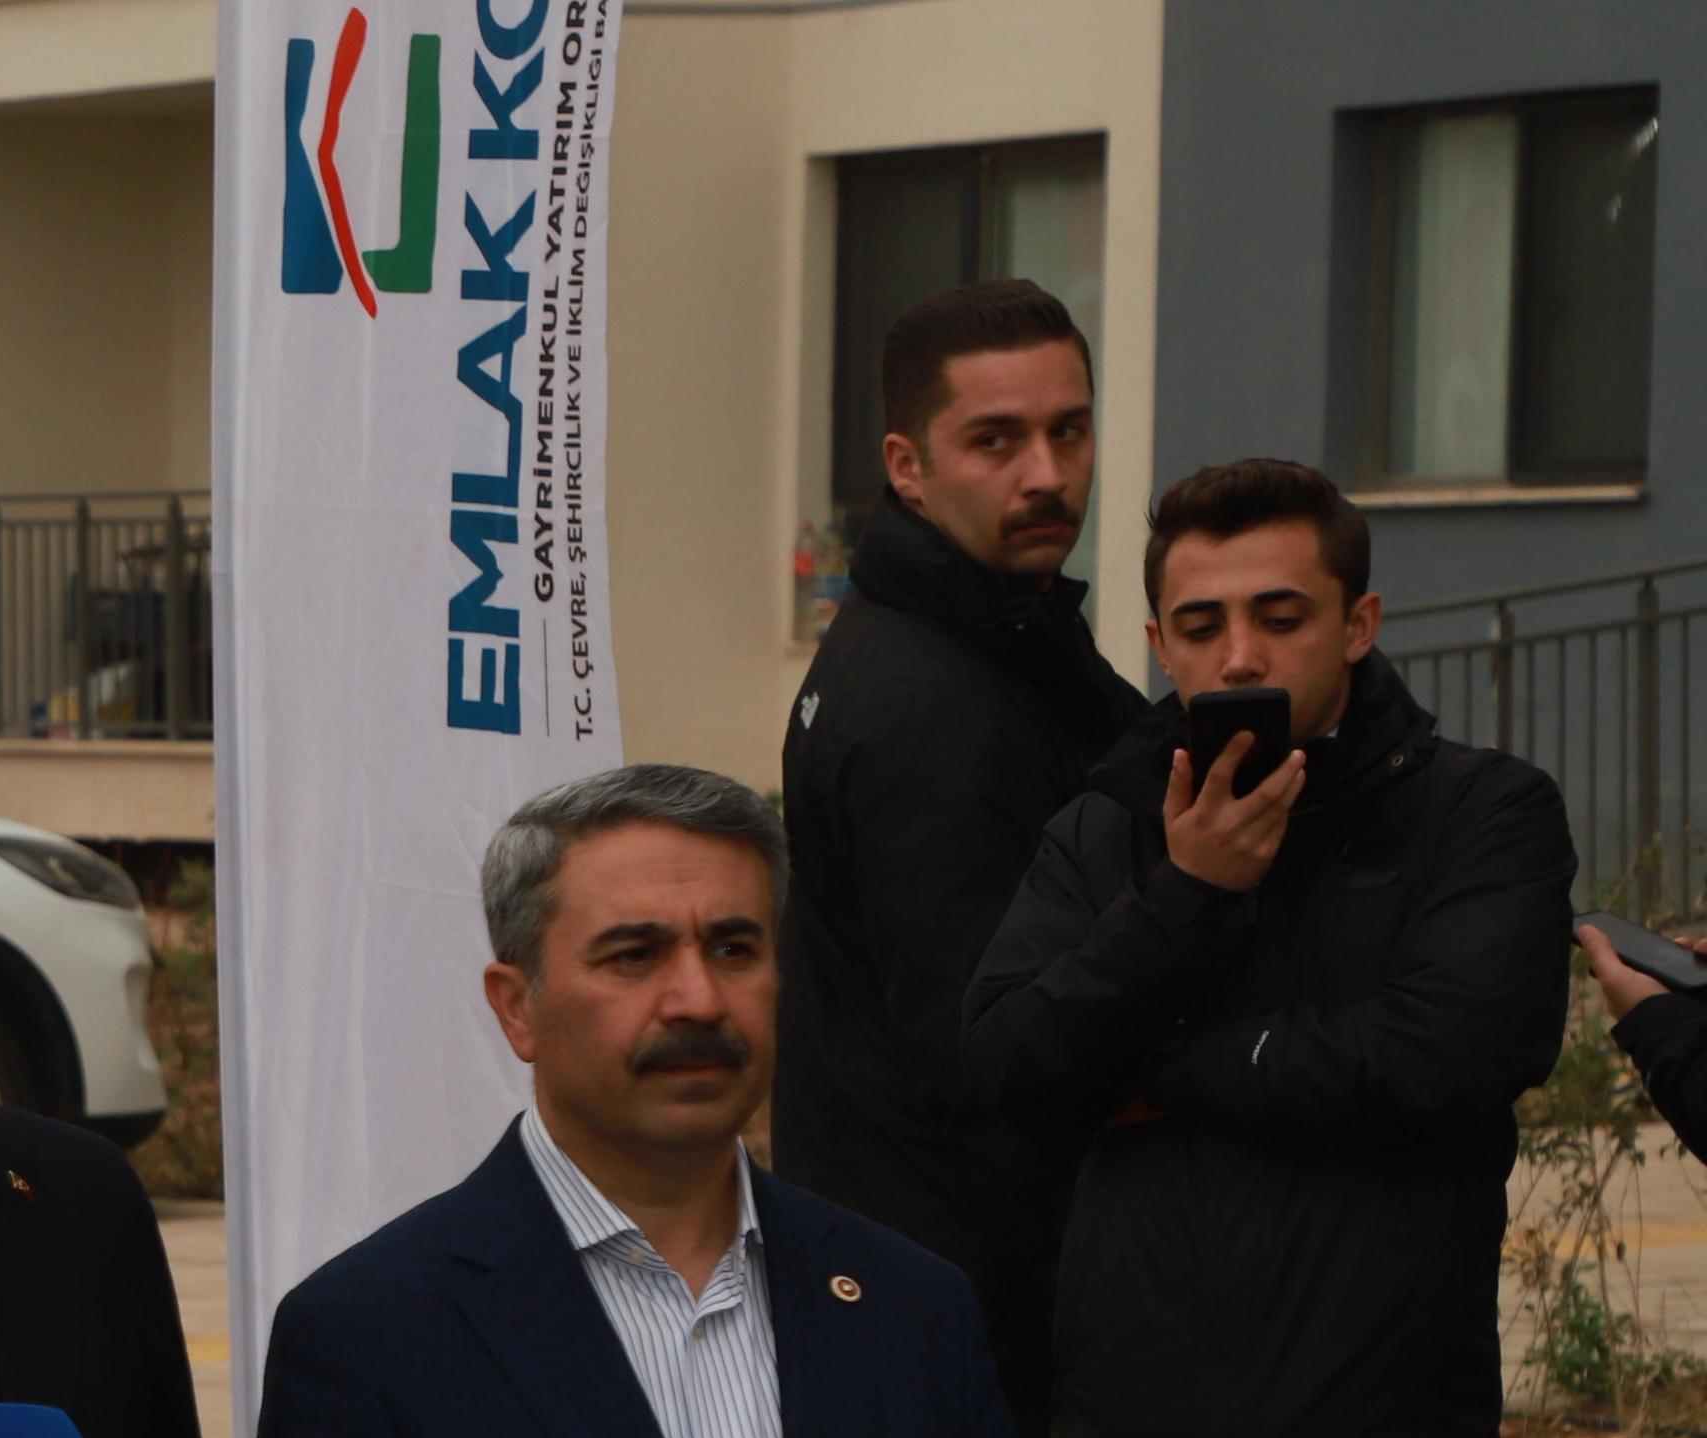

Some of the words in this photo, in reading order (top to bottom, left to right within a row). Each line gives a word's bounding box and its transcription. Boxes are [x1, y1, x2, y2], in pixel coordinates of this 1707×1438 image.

[544, 81, 578, 264] YATIRIM
[573, 49, 603, 238] DEĞİŞİKLİĞİ
[564, 248, 585, 336] İKLİM
[567, 345, 582, 385] VE
[446, 189, 537, 736] EMLAK
[532, 275, 560, 603] GAYRİMENKUL
[563, 391, 587, 564] ŞEHİRCİLİK
[570, 573, 595, 680] ÇEVRE,
[574, 688, 594, 741] T.C.
